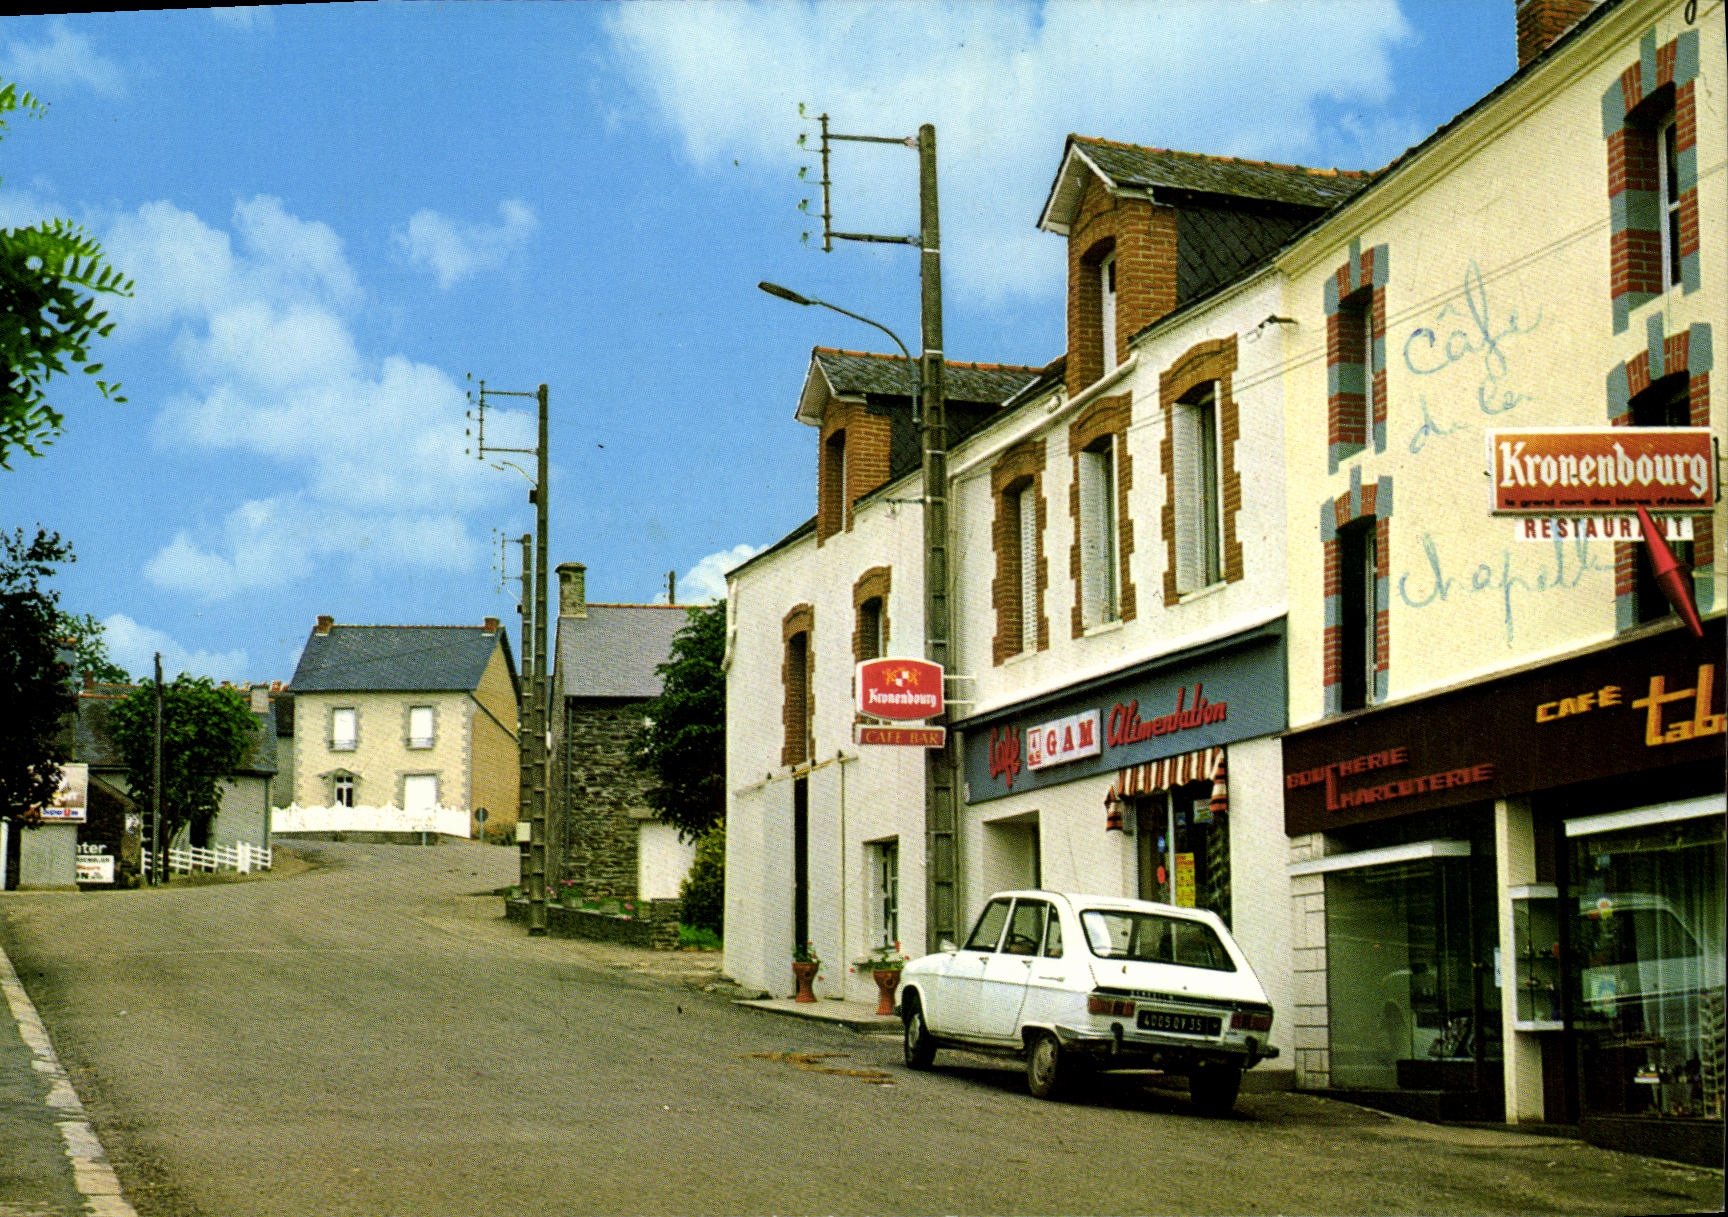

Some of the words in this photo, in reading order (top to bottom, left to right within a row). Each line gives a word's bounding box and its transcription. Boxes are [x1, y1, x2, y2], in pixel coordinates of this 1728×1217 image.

[1499, 441, 1709, 498] Kronenbourg
[1520, 498, 1555, 508] grand
[1524, 517, 1684, 539] RESTAURNT
[868, 688, 937, 708] Kronenbourg
[1107, 684, 1227, 747] Alimentation
[909, 732, 939, 744] BAR
[1046, 719, 1094, 757] GAM
